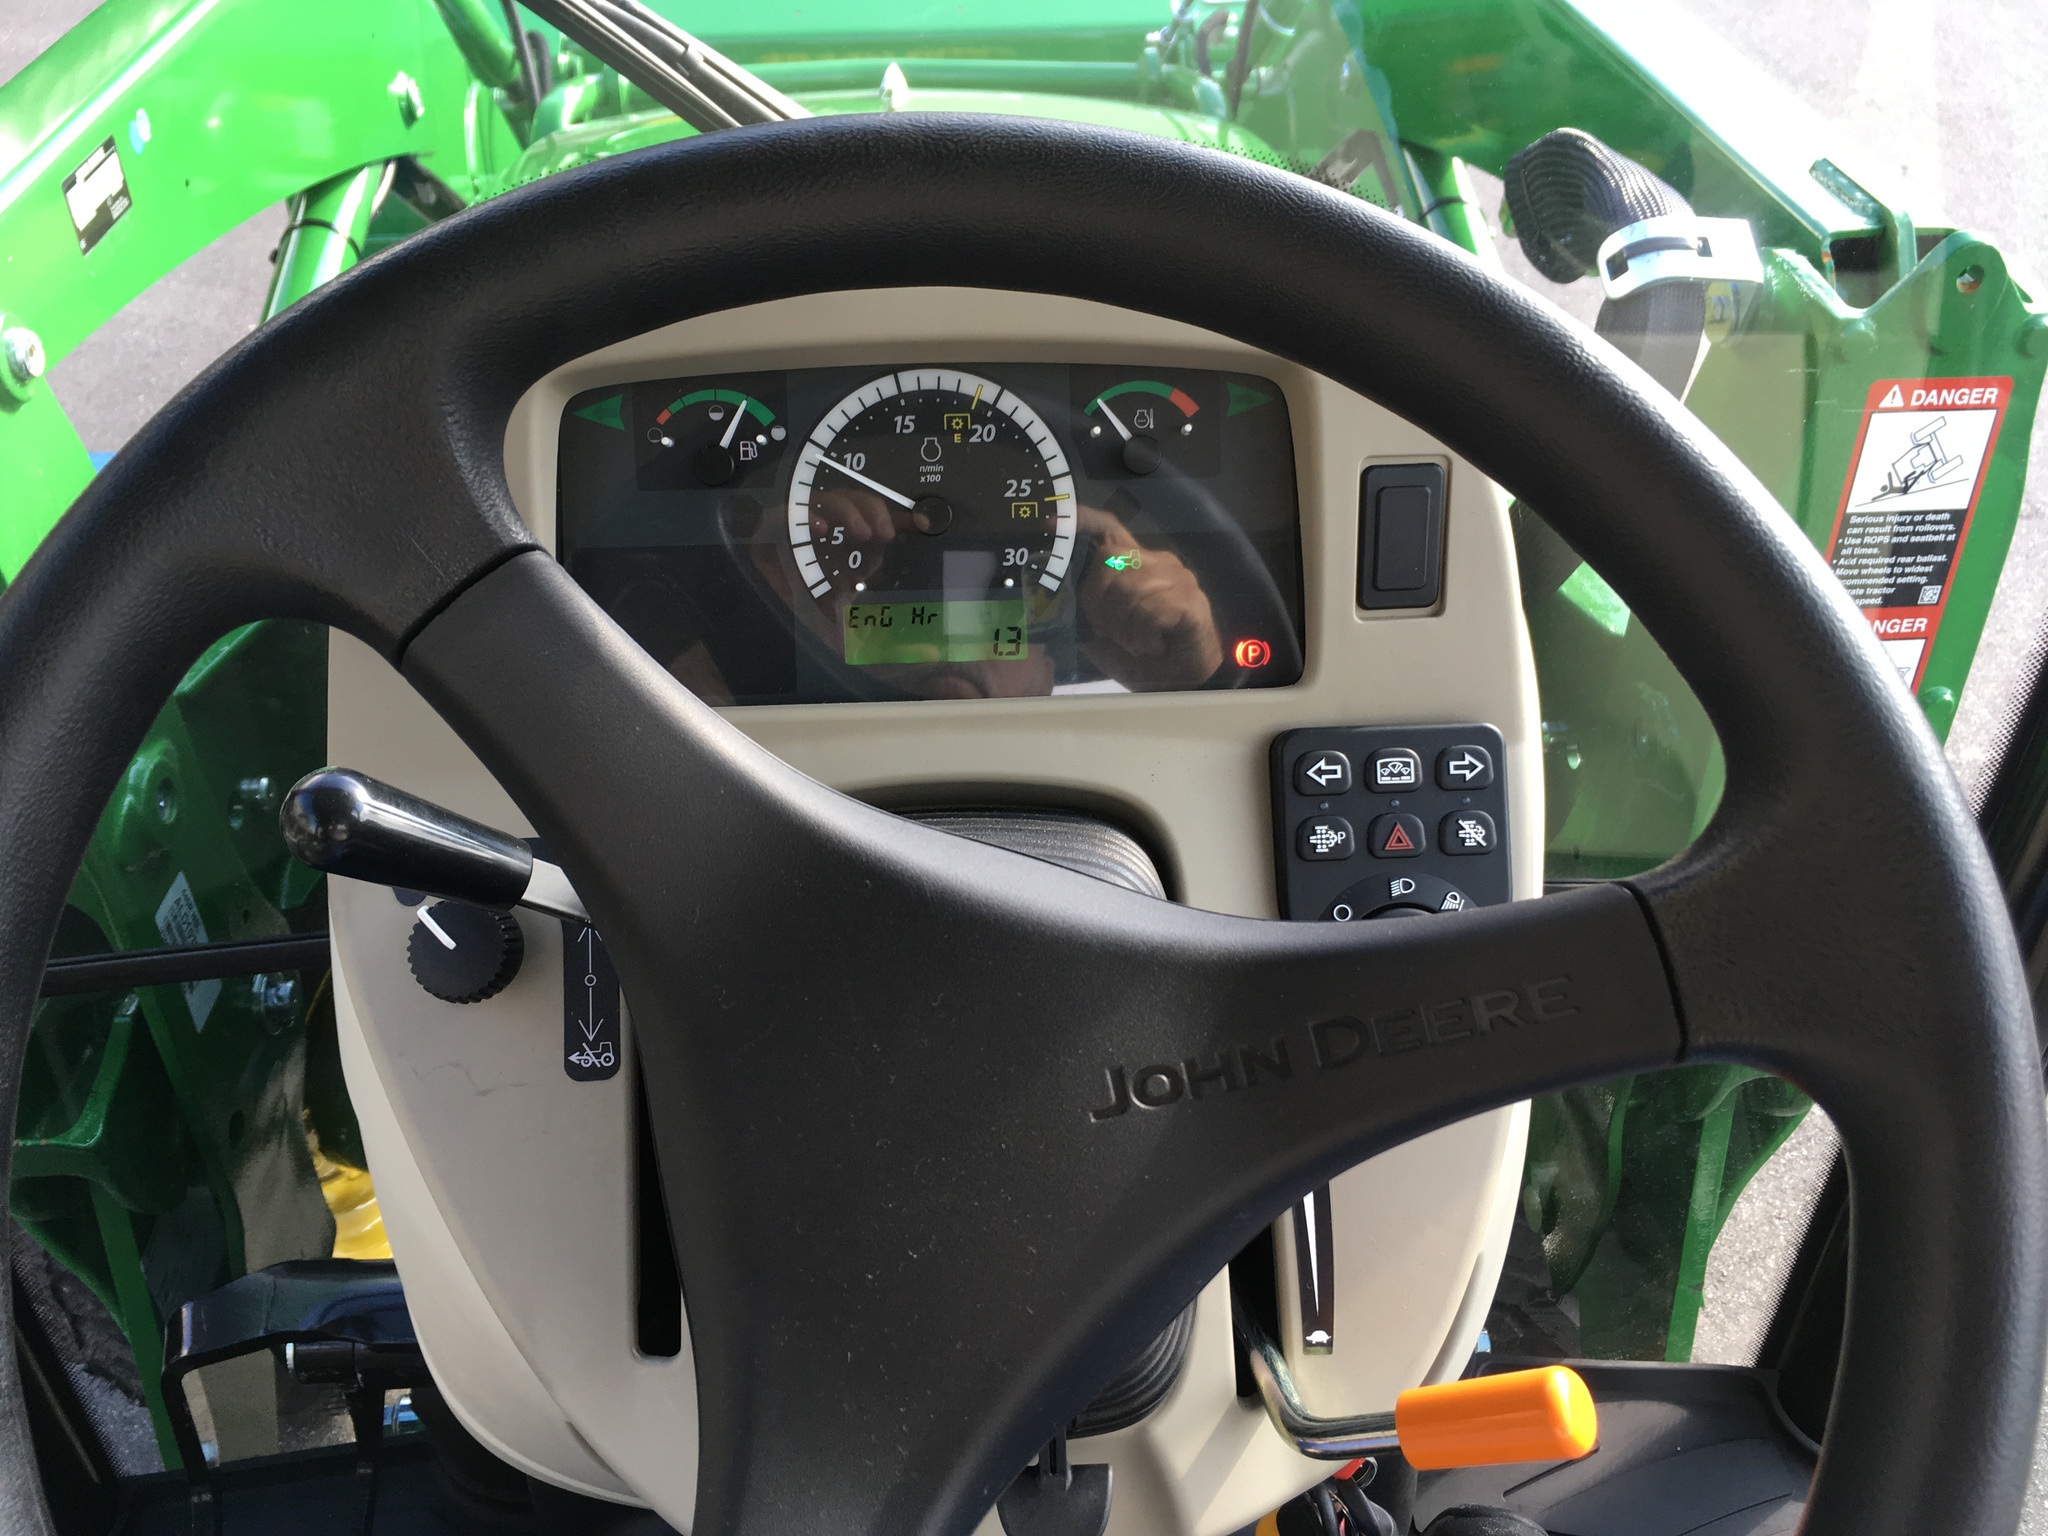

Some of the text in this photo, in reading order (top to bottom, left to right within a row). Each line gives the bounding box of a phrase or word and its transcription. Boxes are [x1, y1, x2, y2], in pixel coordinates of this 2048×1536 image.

[1910, 387, 1999, 406] DANGER
[893, 415, 915, 434] 15
[954, 433, 961, 443] E
[969, 424, 996, 443] 20
[843, 452, 866, 471] 10
[919, 463, 944, 473] n/min
[920, 474, 941, 483] x100
[1004, 479, 1032, 497] 25
[1850, 515, 1884, 524] Serious
[1886, 514, 1912, 524] injury
[1925, 512, 1950, 521] death
[1846, 523, 1956, 534] can result from rollovers.
[831, 527, 844, 545] 5
[1844, 533, 1957, 545] Use ROPS and seatbelt at
[1002, 547, 1029, 565] 30
[1841, 546, 1880, 556] all times.
[848, 550, 862, 569] 0
[1858, 556, 1895, 567] required
[1896, 556, 1916, 564] rear
[1916, 554, 1948, 562] ballast.
[1835, 564, 1934, 576] Move wheels to widest
[1841, 575, 1929, 586] commended setting.
[1865, 586, 1896, 595] tractor
[911, 606, 938, 625] Hr
[1871, 618, 1928, 634] NGER
[1088, 974, 1582, 1123] JOHN DEERE
